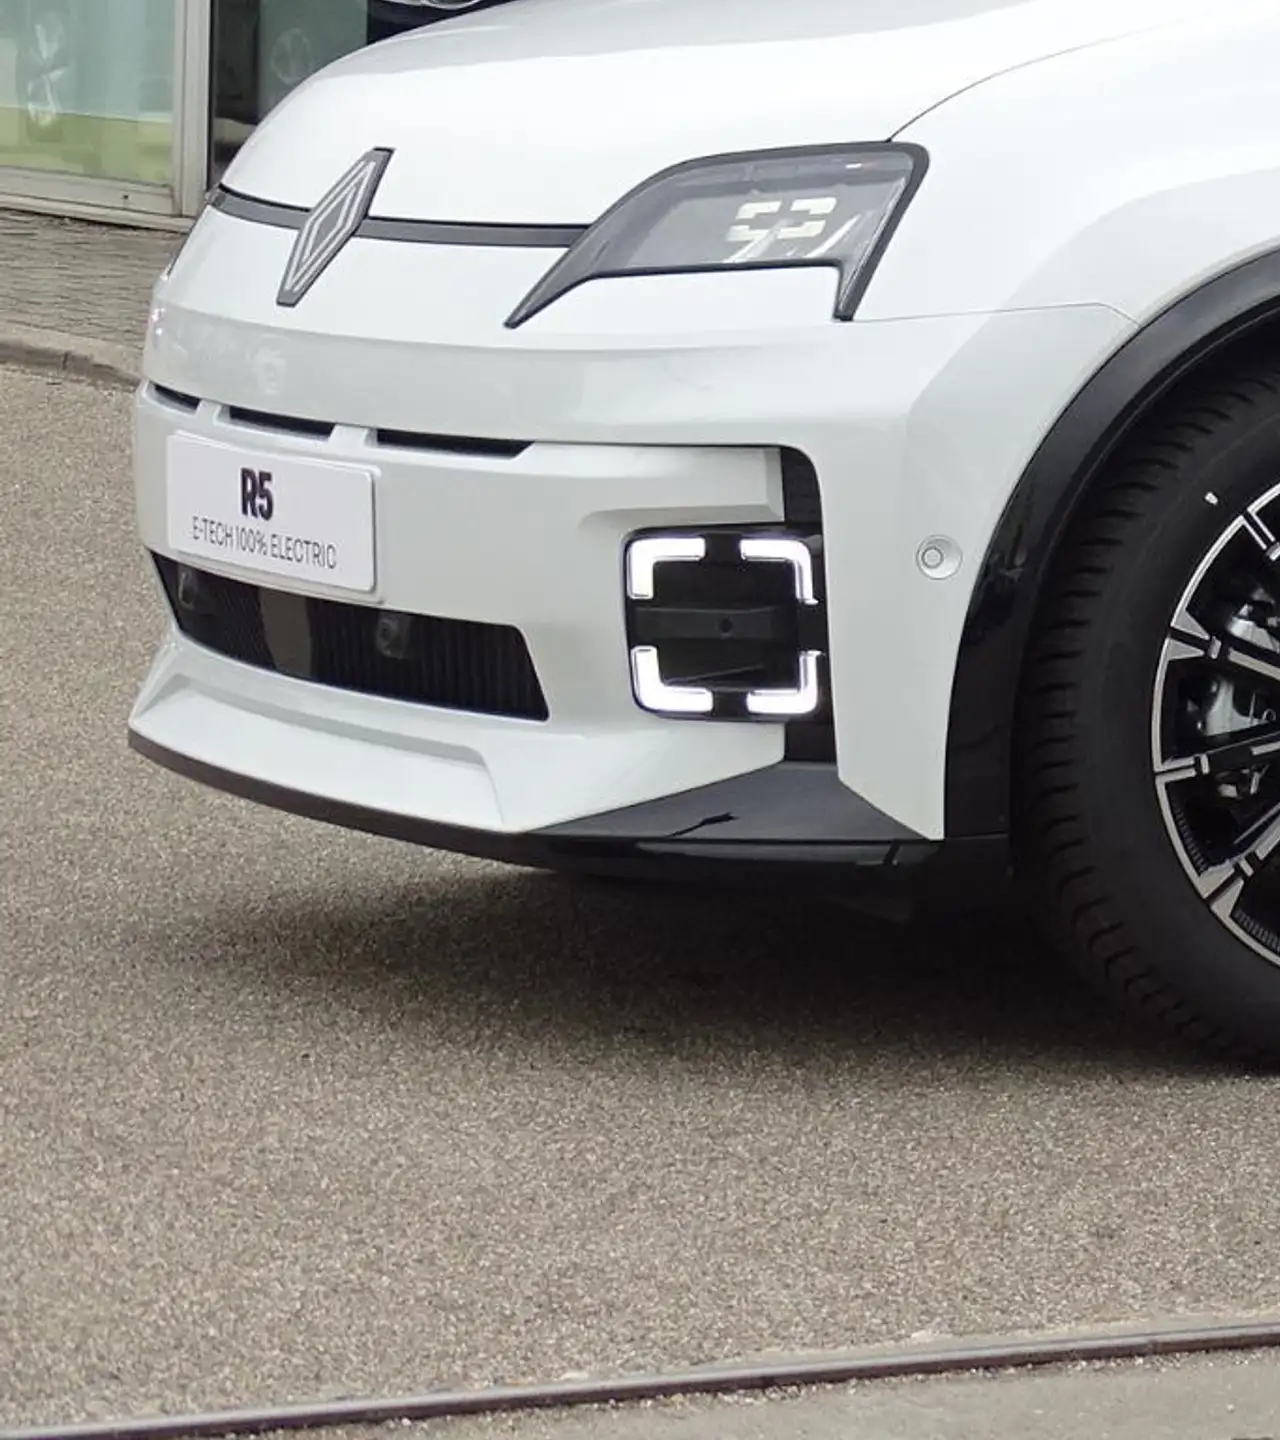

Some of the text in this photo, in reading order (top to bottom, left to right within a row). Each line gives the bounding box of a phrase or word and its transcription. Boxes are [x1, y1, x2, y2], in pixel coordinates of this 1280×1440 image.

[240, 467, 274, 521] R5
[192, 515, 337, 569] E-TECH 100% ELECTRIC
